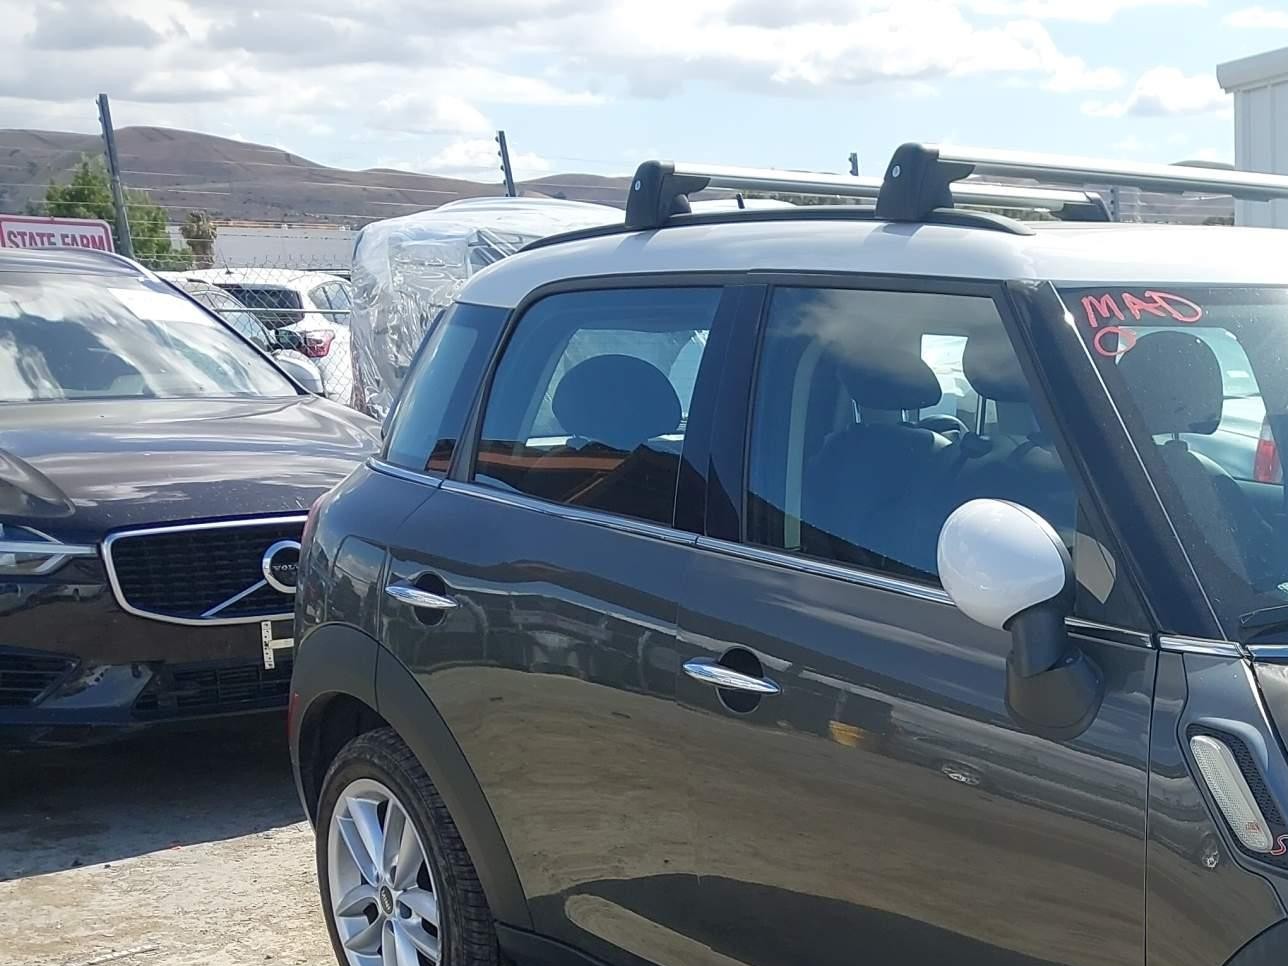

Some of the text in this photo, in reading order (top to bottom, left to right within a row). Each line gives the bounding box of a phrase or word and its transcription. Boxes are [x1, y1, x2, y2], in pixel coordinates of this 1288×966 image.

[6, 230, 106, 251] STATE FARM
[1081, 290, 1202, 327] MAD
